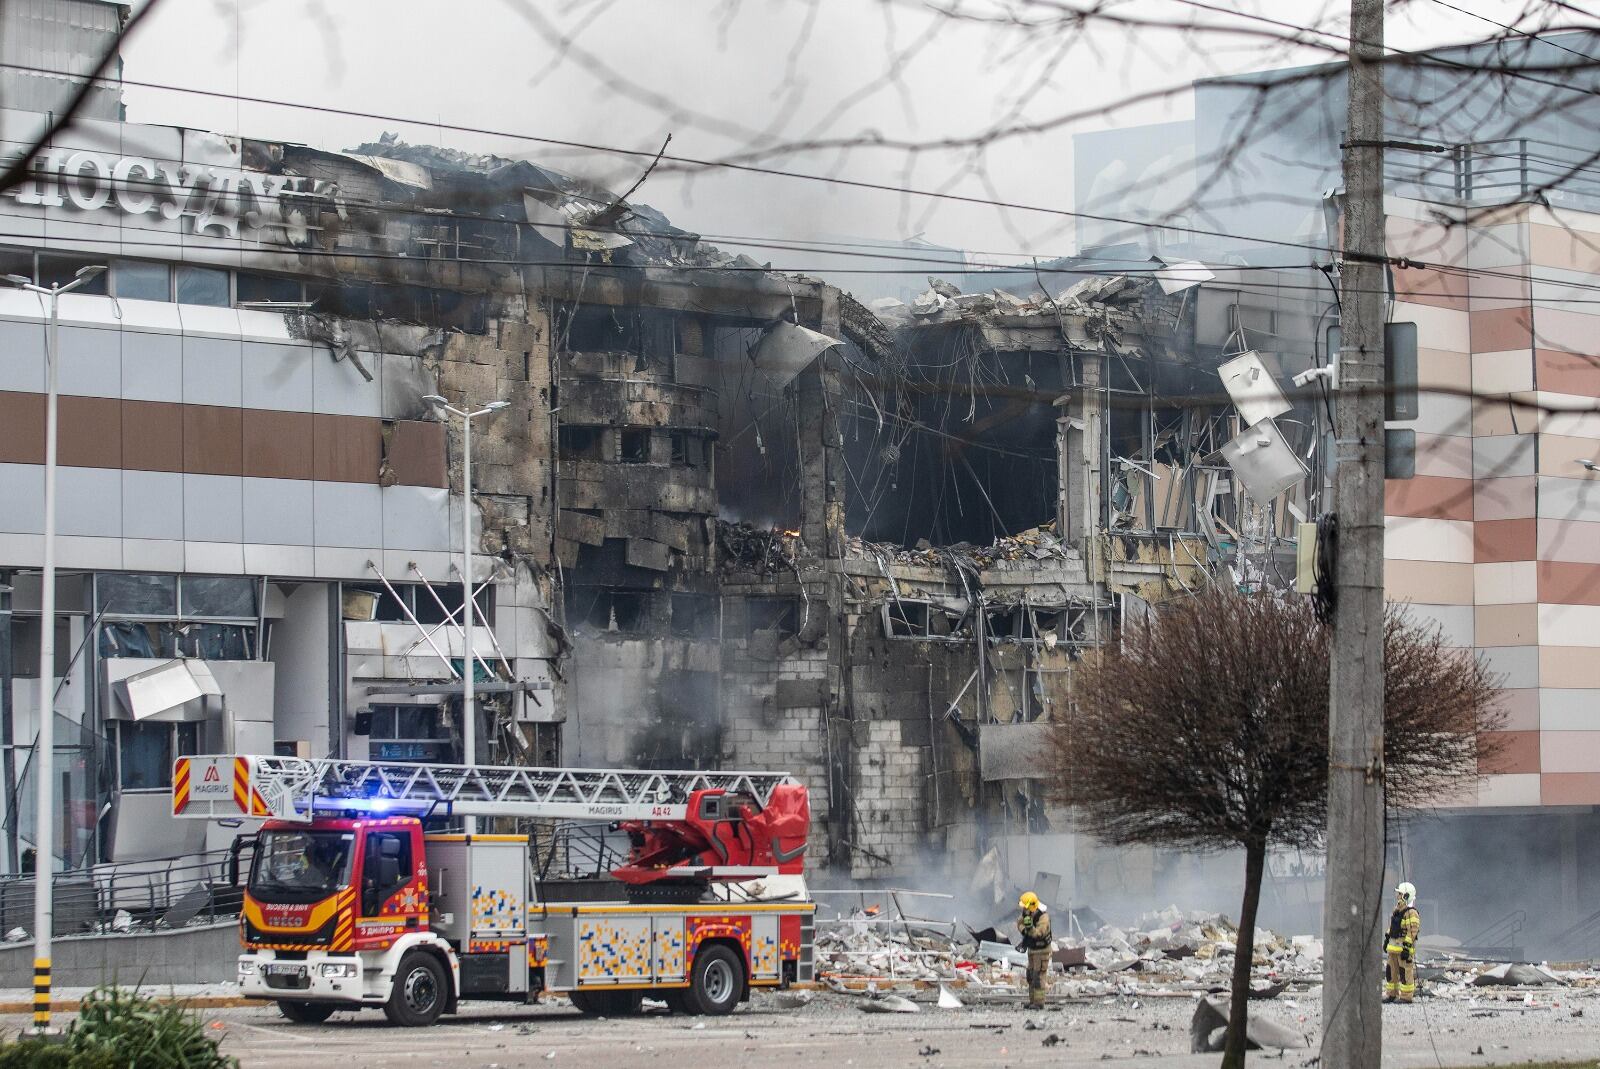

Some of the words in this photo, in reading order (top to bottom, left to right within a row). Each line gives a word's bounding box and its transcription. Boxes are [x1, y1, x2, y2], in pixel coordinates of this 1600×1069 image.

[194, 784, 229, 793] MAGIRUS
[588, 806, 622, 815] MAGIRUS
[663, 807, 672, 816] 42
[268, 916, 303, 927] IVECO
